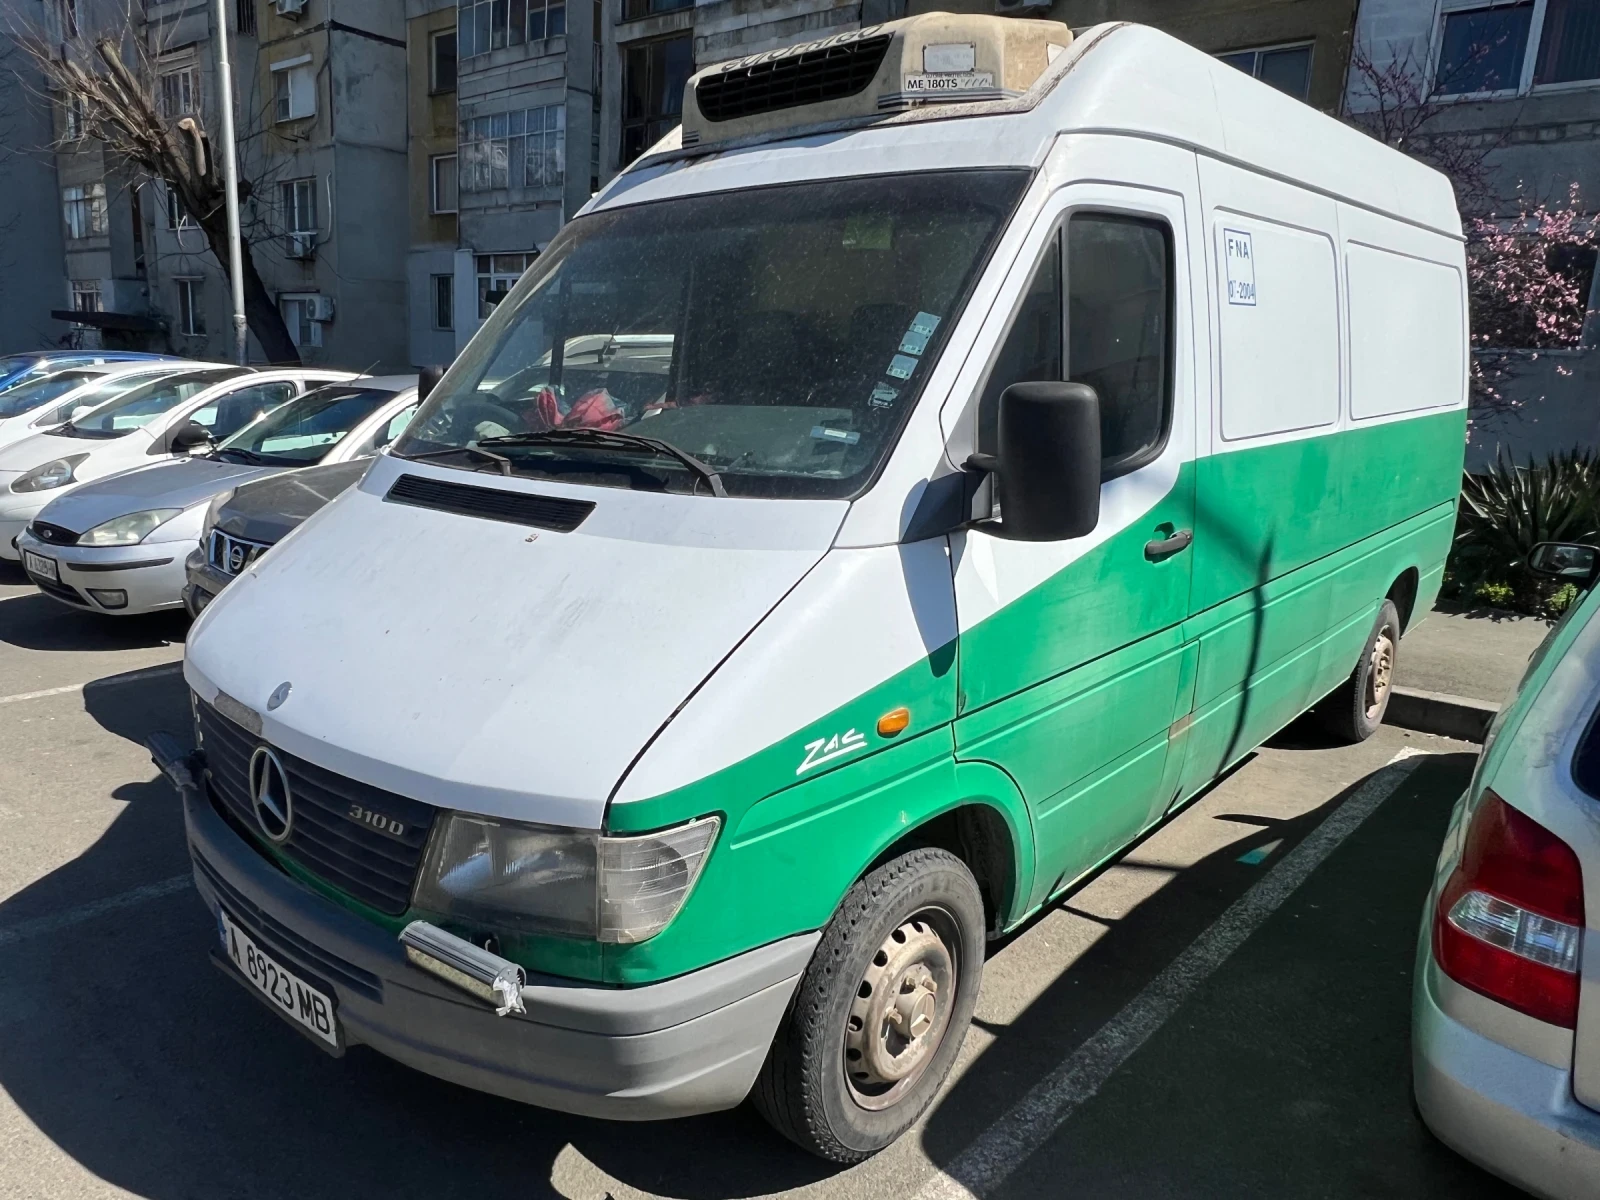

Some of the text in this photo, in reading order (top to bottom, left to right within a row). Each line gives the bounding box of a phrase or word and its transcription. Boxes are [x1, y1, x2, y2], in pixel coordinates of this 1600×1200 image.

[907, 79, 924, 89] ME
[1228, 238, 1250, 259] FNA
[247, 944, 294, 1010] 8923
[296, 981, 330, 1035] MB
